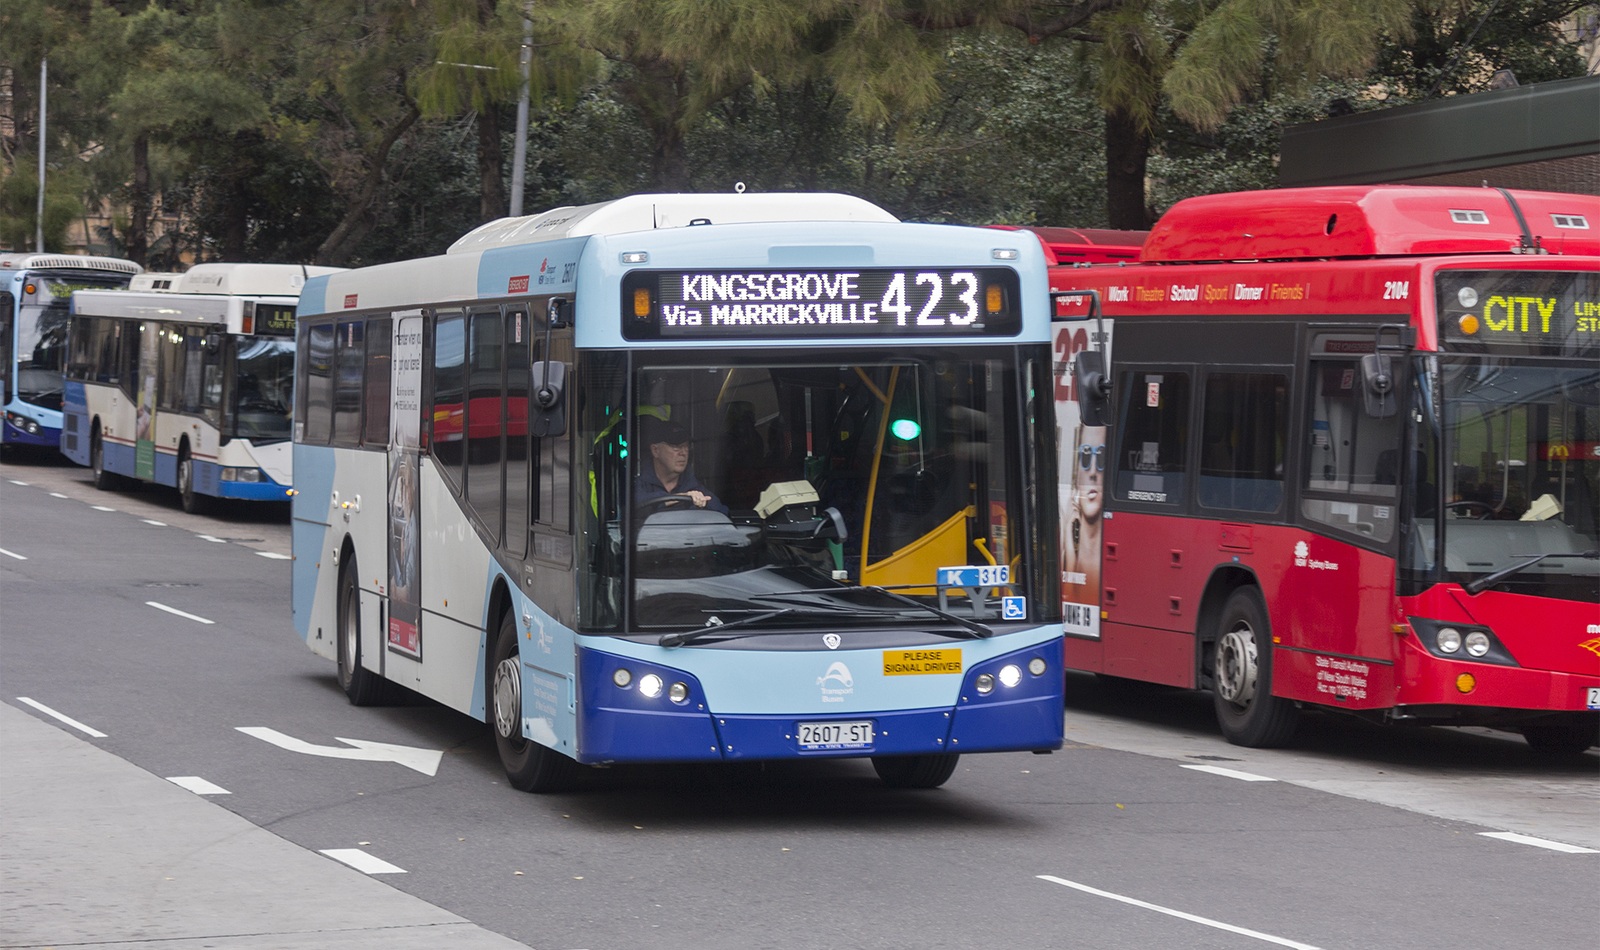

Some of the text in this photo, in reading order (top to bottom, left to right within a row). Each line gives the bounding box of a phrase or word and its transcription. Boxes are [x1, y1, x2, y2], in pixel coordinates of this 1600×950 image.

[682, 273, 860, 301] KINGSGROVE
[1108, 286, 1129, 302] Work
[1136, 286, 1165, 302] Theatre
[1170, 284, 1200, 301] School
[1204, 284, 1229, 304] Sport
[1234, 283, 1264, 301] Dinner
[1270, 283, 1304, 300] Friends
[1382, 281, 1409, 300] 2104
[880, 272, 979, 326] 423
[662, 303, 879, 326] Via MARRICKVILLE
[1483, 295, 1557, 333] CITY
[946, 566, 1009, 586] K 316
[903, 651, 942, 661] PLEASE
[1315, 655, 1330, 668] State
[885, 661, 962, 673] SIGNAL DRIVER
[820, 687, 854, 695] Transport
[821, 695, 845, 703] Buses
